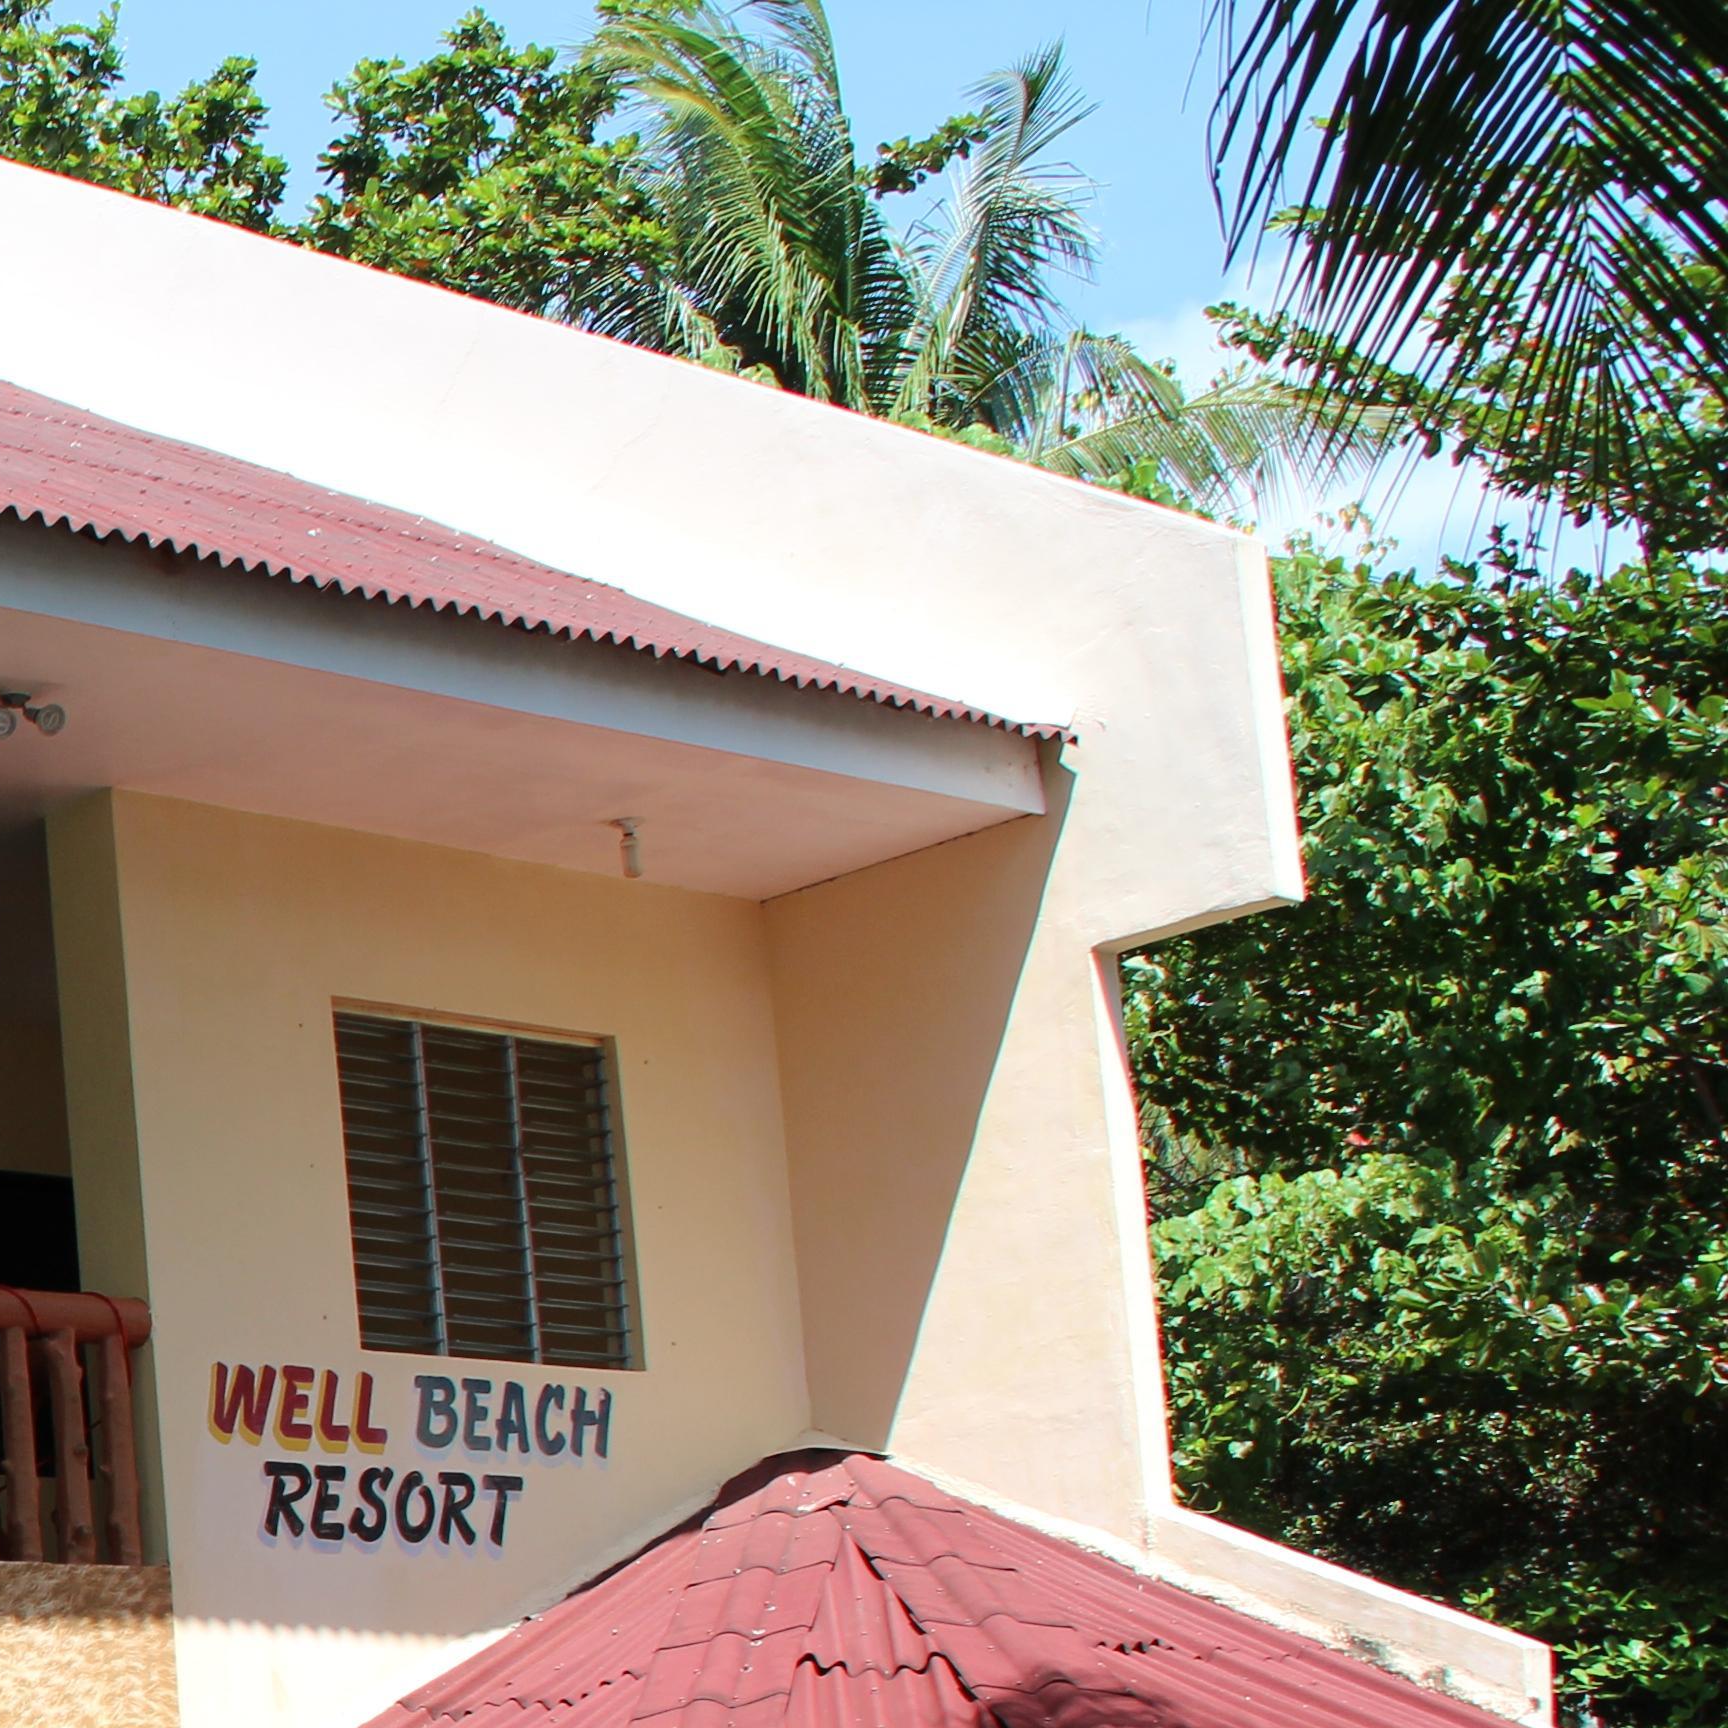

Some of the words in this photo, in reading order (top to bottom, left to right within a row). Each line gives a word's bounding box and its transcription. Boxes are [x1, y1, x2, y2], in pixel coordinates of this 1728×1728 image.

[207, 1361, 387, 1455] WELL
[414, 1375, 612, 1459] BEACH
[263, 1461, 523, 1547] RESORT
